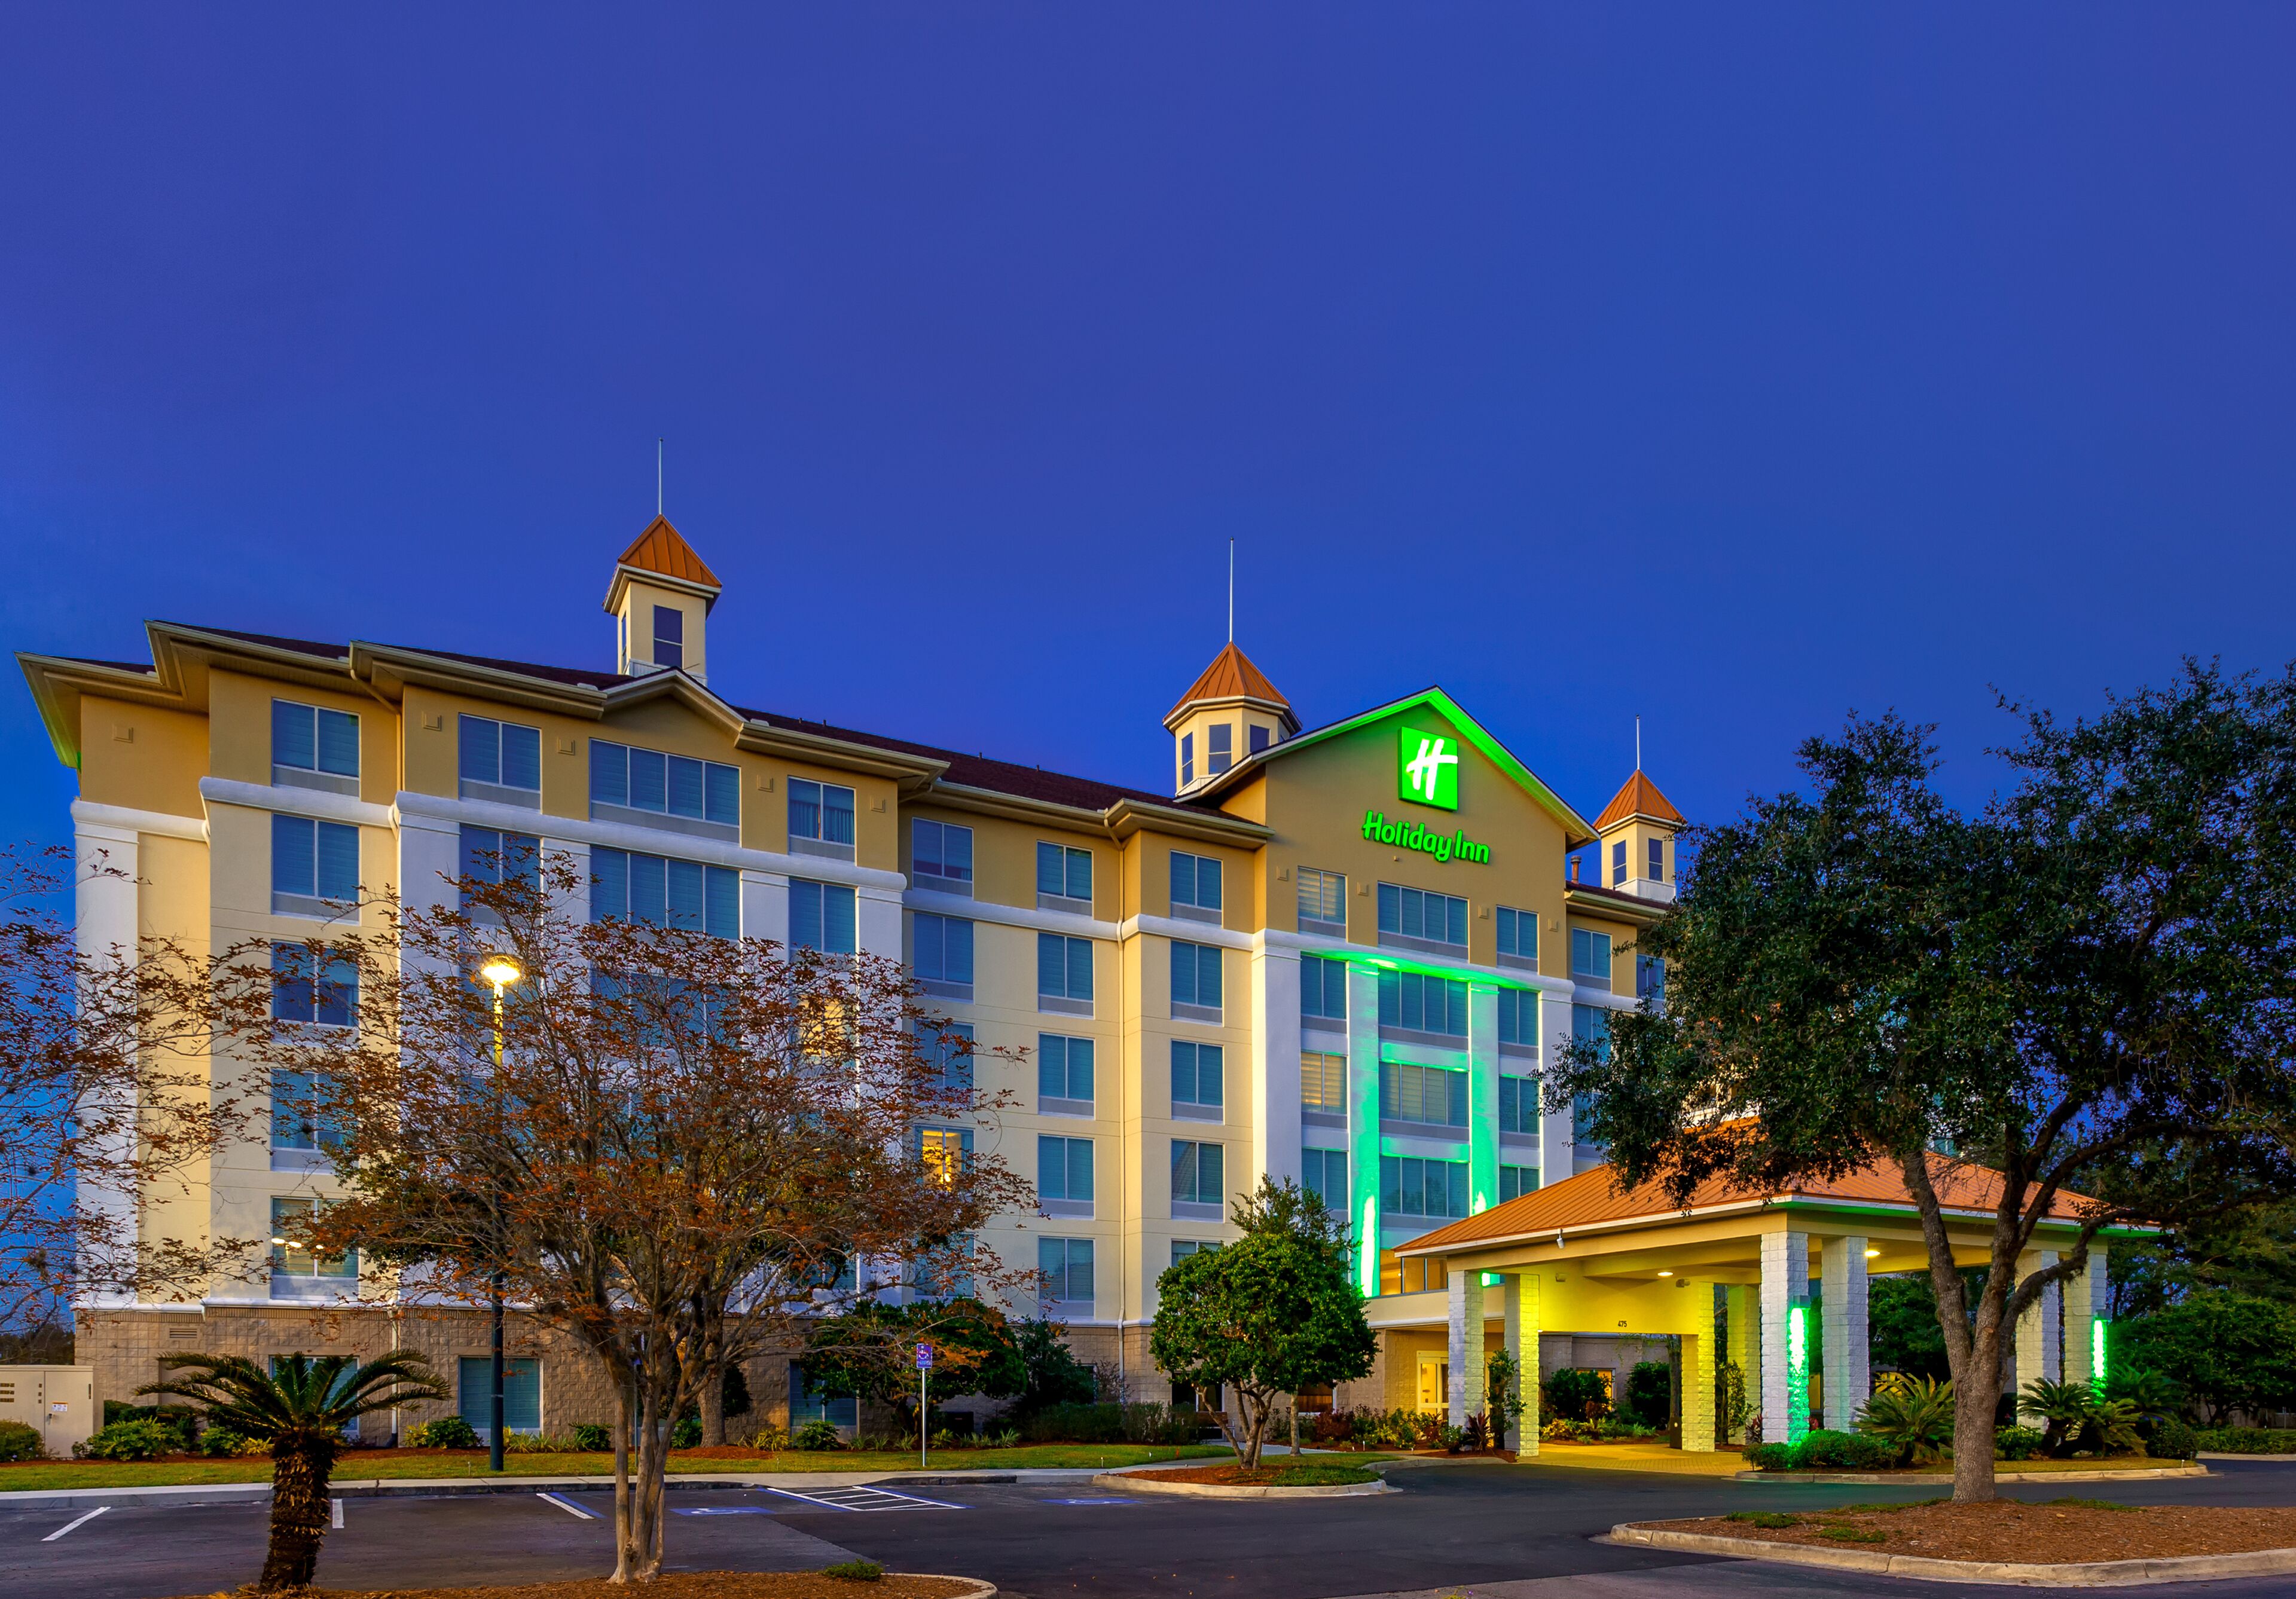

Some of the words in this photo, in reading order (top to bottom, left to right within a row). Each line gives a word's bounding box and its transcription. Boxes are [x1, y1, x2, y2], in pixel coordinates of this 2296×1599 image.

[1406, 738, 1458, 800] H
[1362, 811, 1452, 862] Holiday
[1454, 830, 1489, 864] Inn
